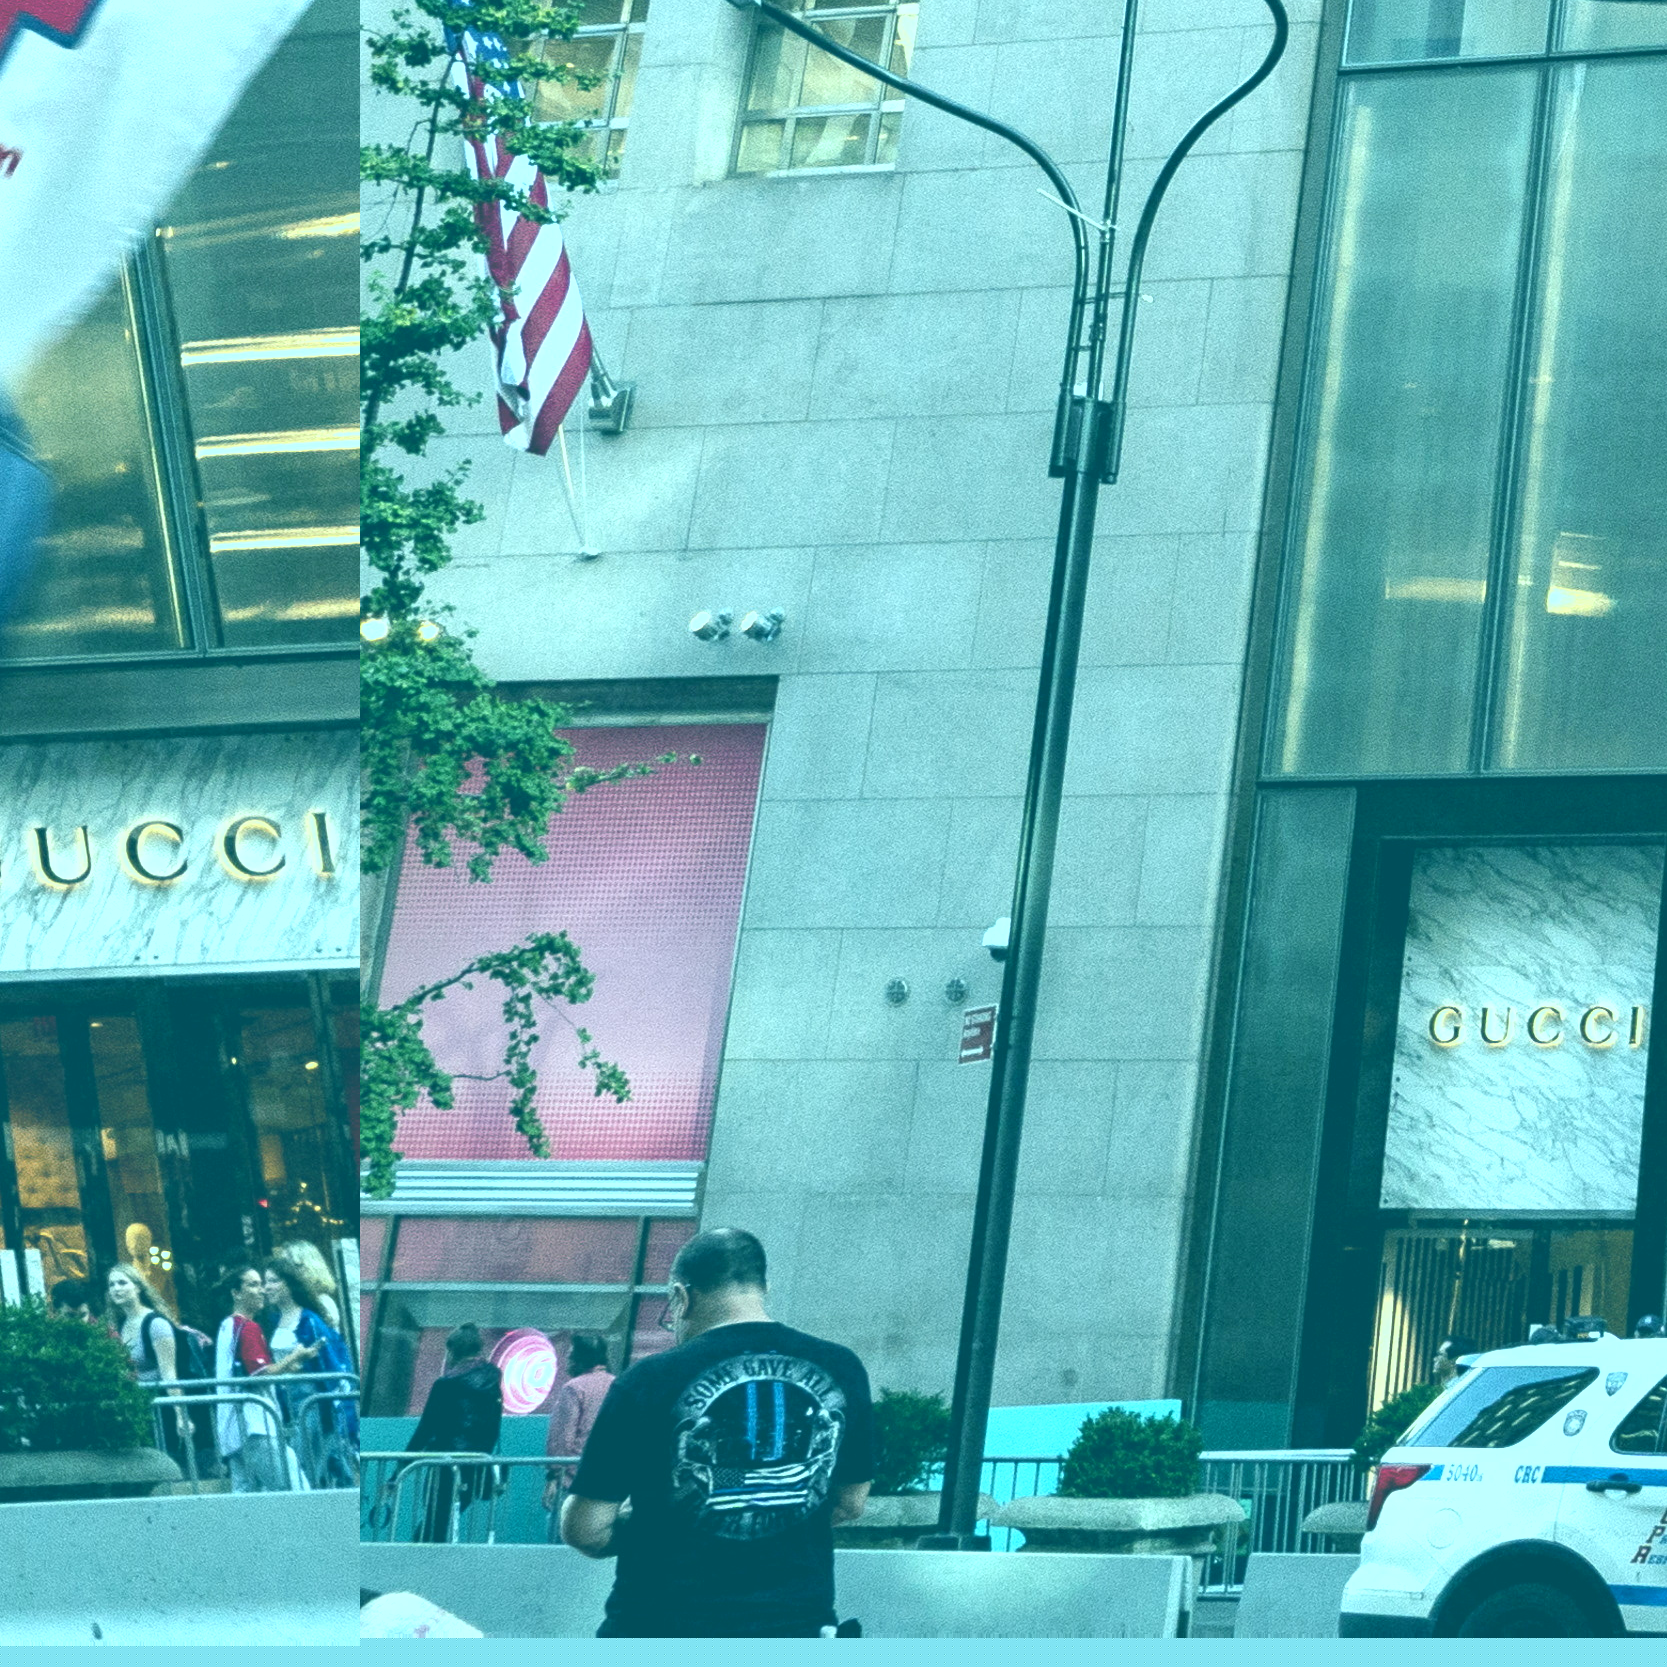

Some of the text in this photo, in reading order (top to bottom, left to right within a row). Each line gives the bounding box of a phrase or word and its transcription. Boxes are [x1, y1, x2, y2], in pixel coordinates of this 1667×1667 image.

[0, 811, 336, 885] UCCI
[1428, 1005, 1643, 1045] GUCCI
[684, 1358, 831, 1410] SOME GAVE ALL
